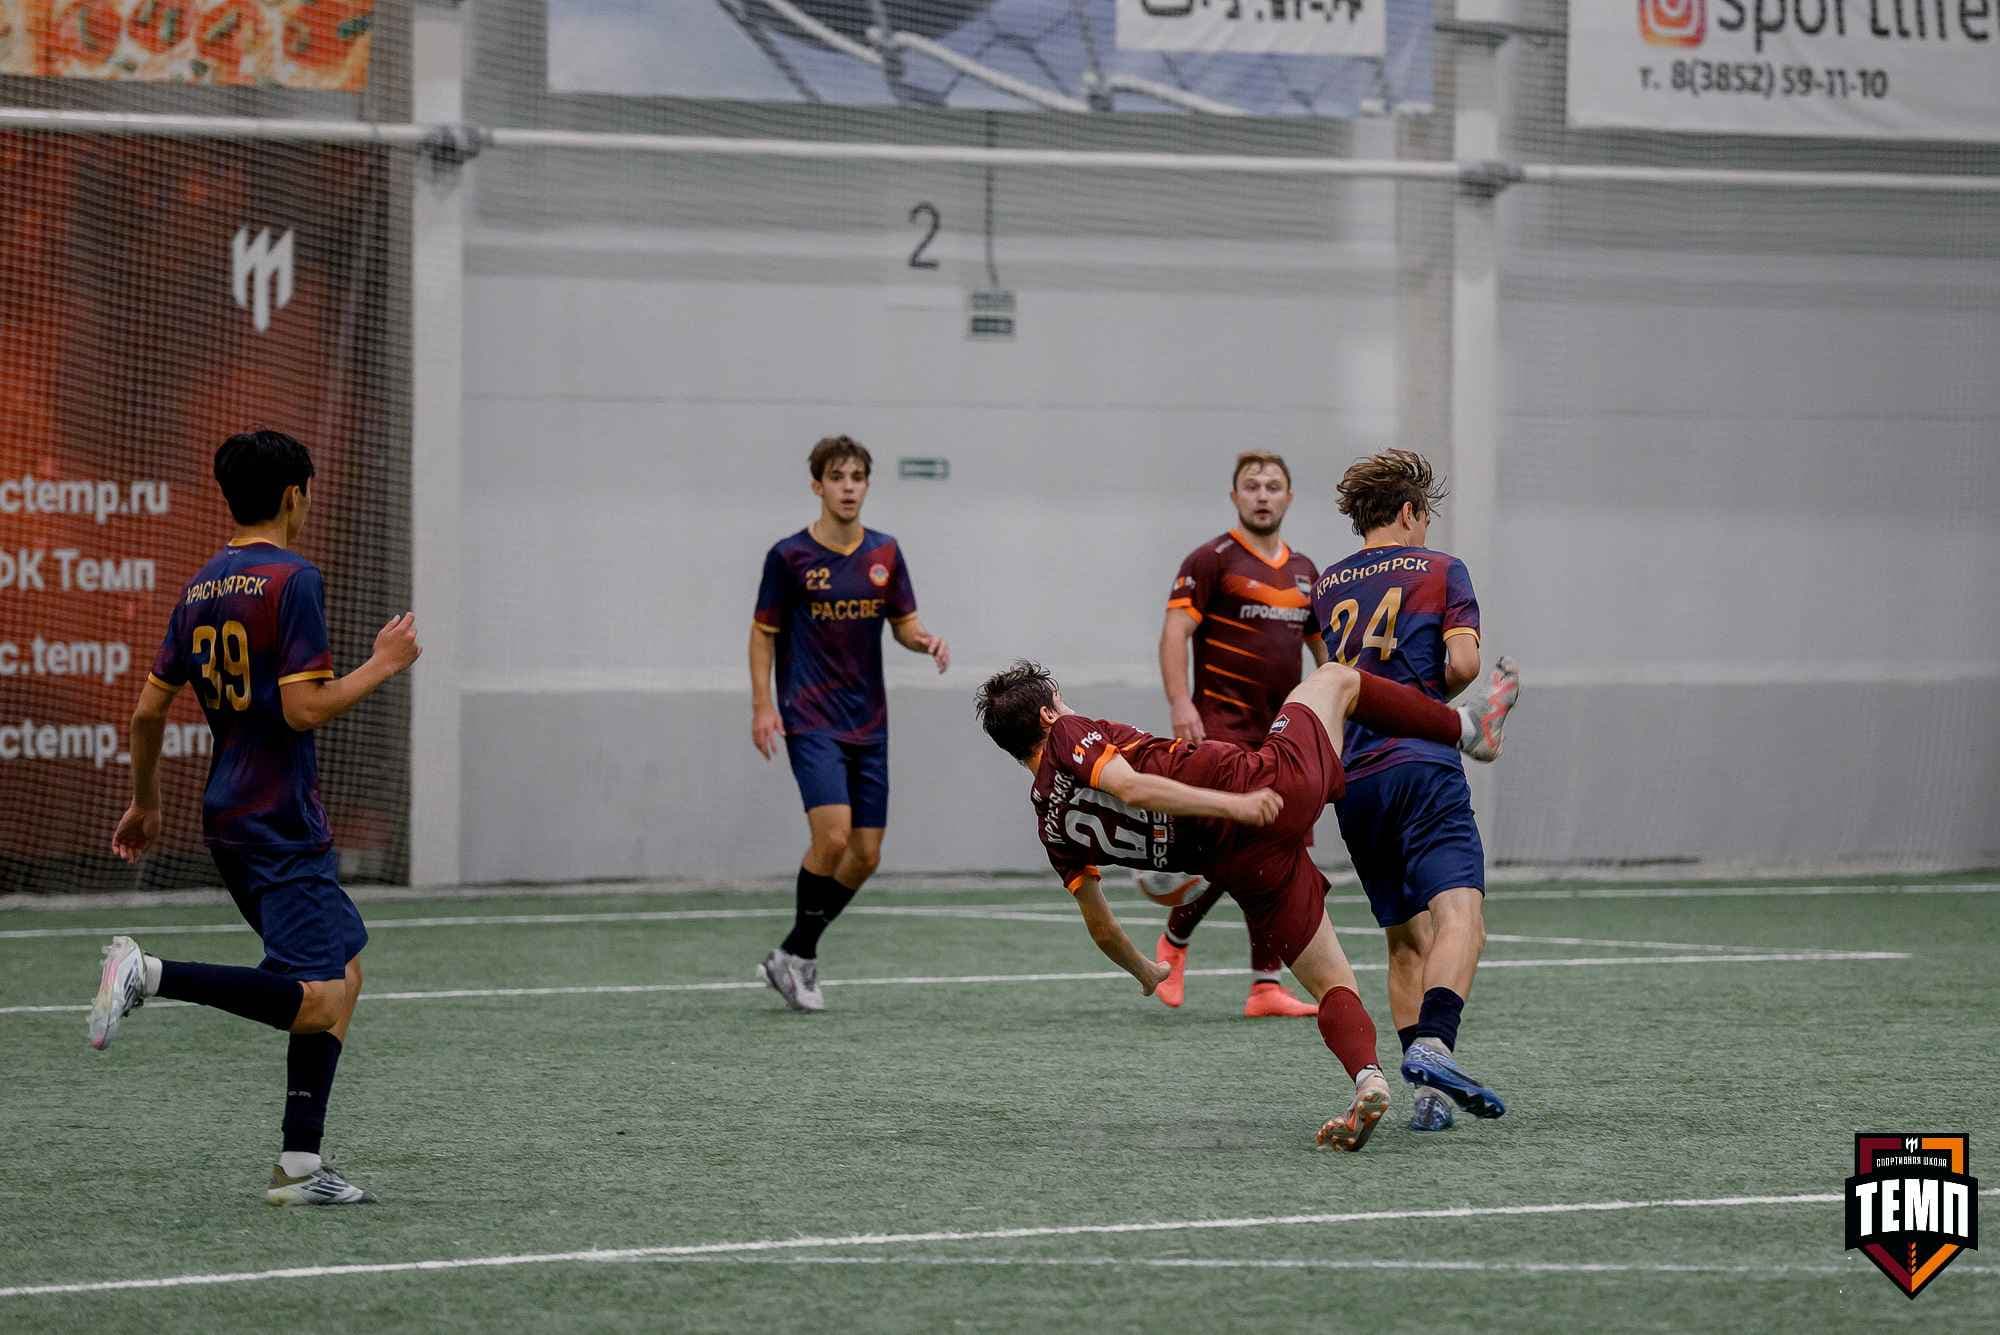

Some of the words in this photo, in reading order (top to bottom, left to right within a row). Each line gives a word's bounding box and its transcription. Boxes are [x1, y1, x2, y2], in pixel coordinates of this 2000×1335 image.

[1671, 59, 1775, 99] 8(3852)
[1782, 65, 1888, 98] 59-11-10
[909, 202, 941, 269] 2
[0, 473, 170, 524] ctemp.ru
[52, 549, 156, 591] Темп
[805, 567, 832, 591] 22
[1316, 556, 1431, 600] КРАСНОЯРСК
[1329, 586, 1403, 668] 24
[0, 633, 130, 684] c.temp
[192, 619, 251, 712] 39
